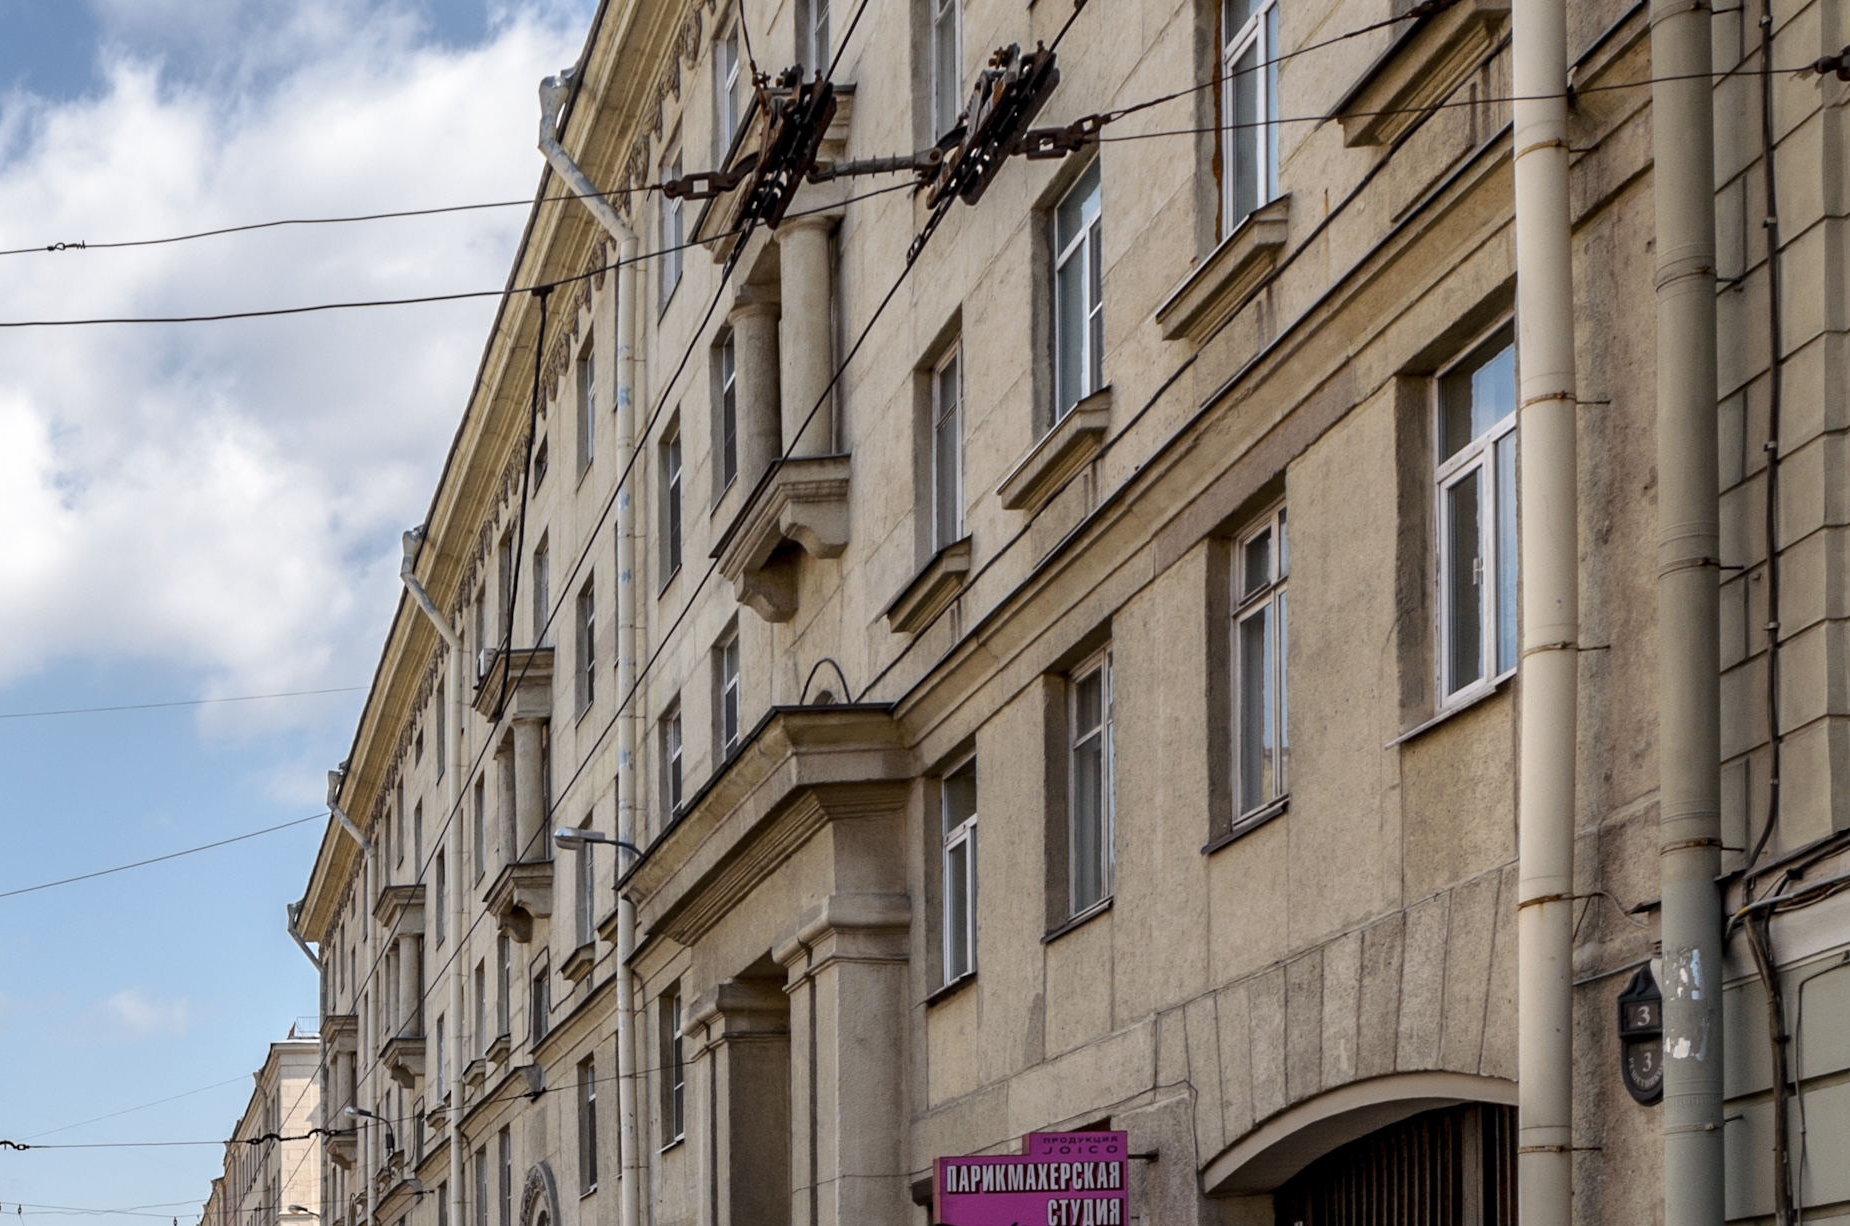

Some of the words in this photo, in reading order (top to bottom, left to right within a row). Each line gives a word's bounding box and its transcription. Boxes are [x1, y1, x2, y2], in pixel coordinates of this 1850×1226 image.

[1637, 1006, 1651, 1026] 3
[1642, 1052, 1652, 1072] 3
[1043, 1136, 1118, 1145] ПРОДУКЦИЯ
[1043, 1145, 1118, 1155] JOICO
[946, 1161, 1123, 1193] ПАРИКМАХЕРСКАЯ
